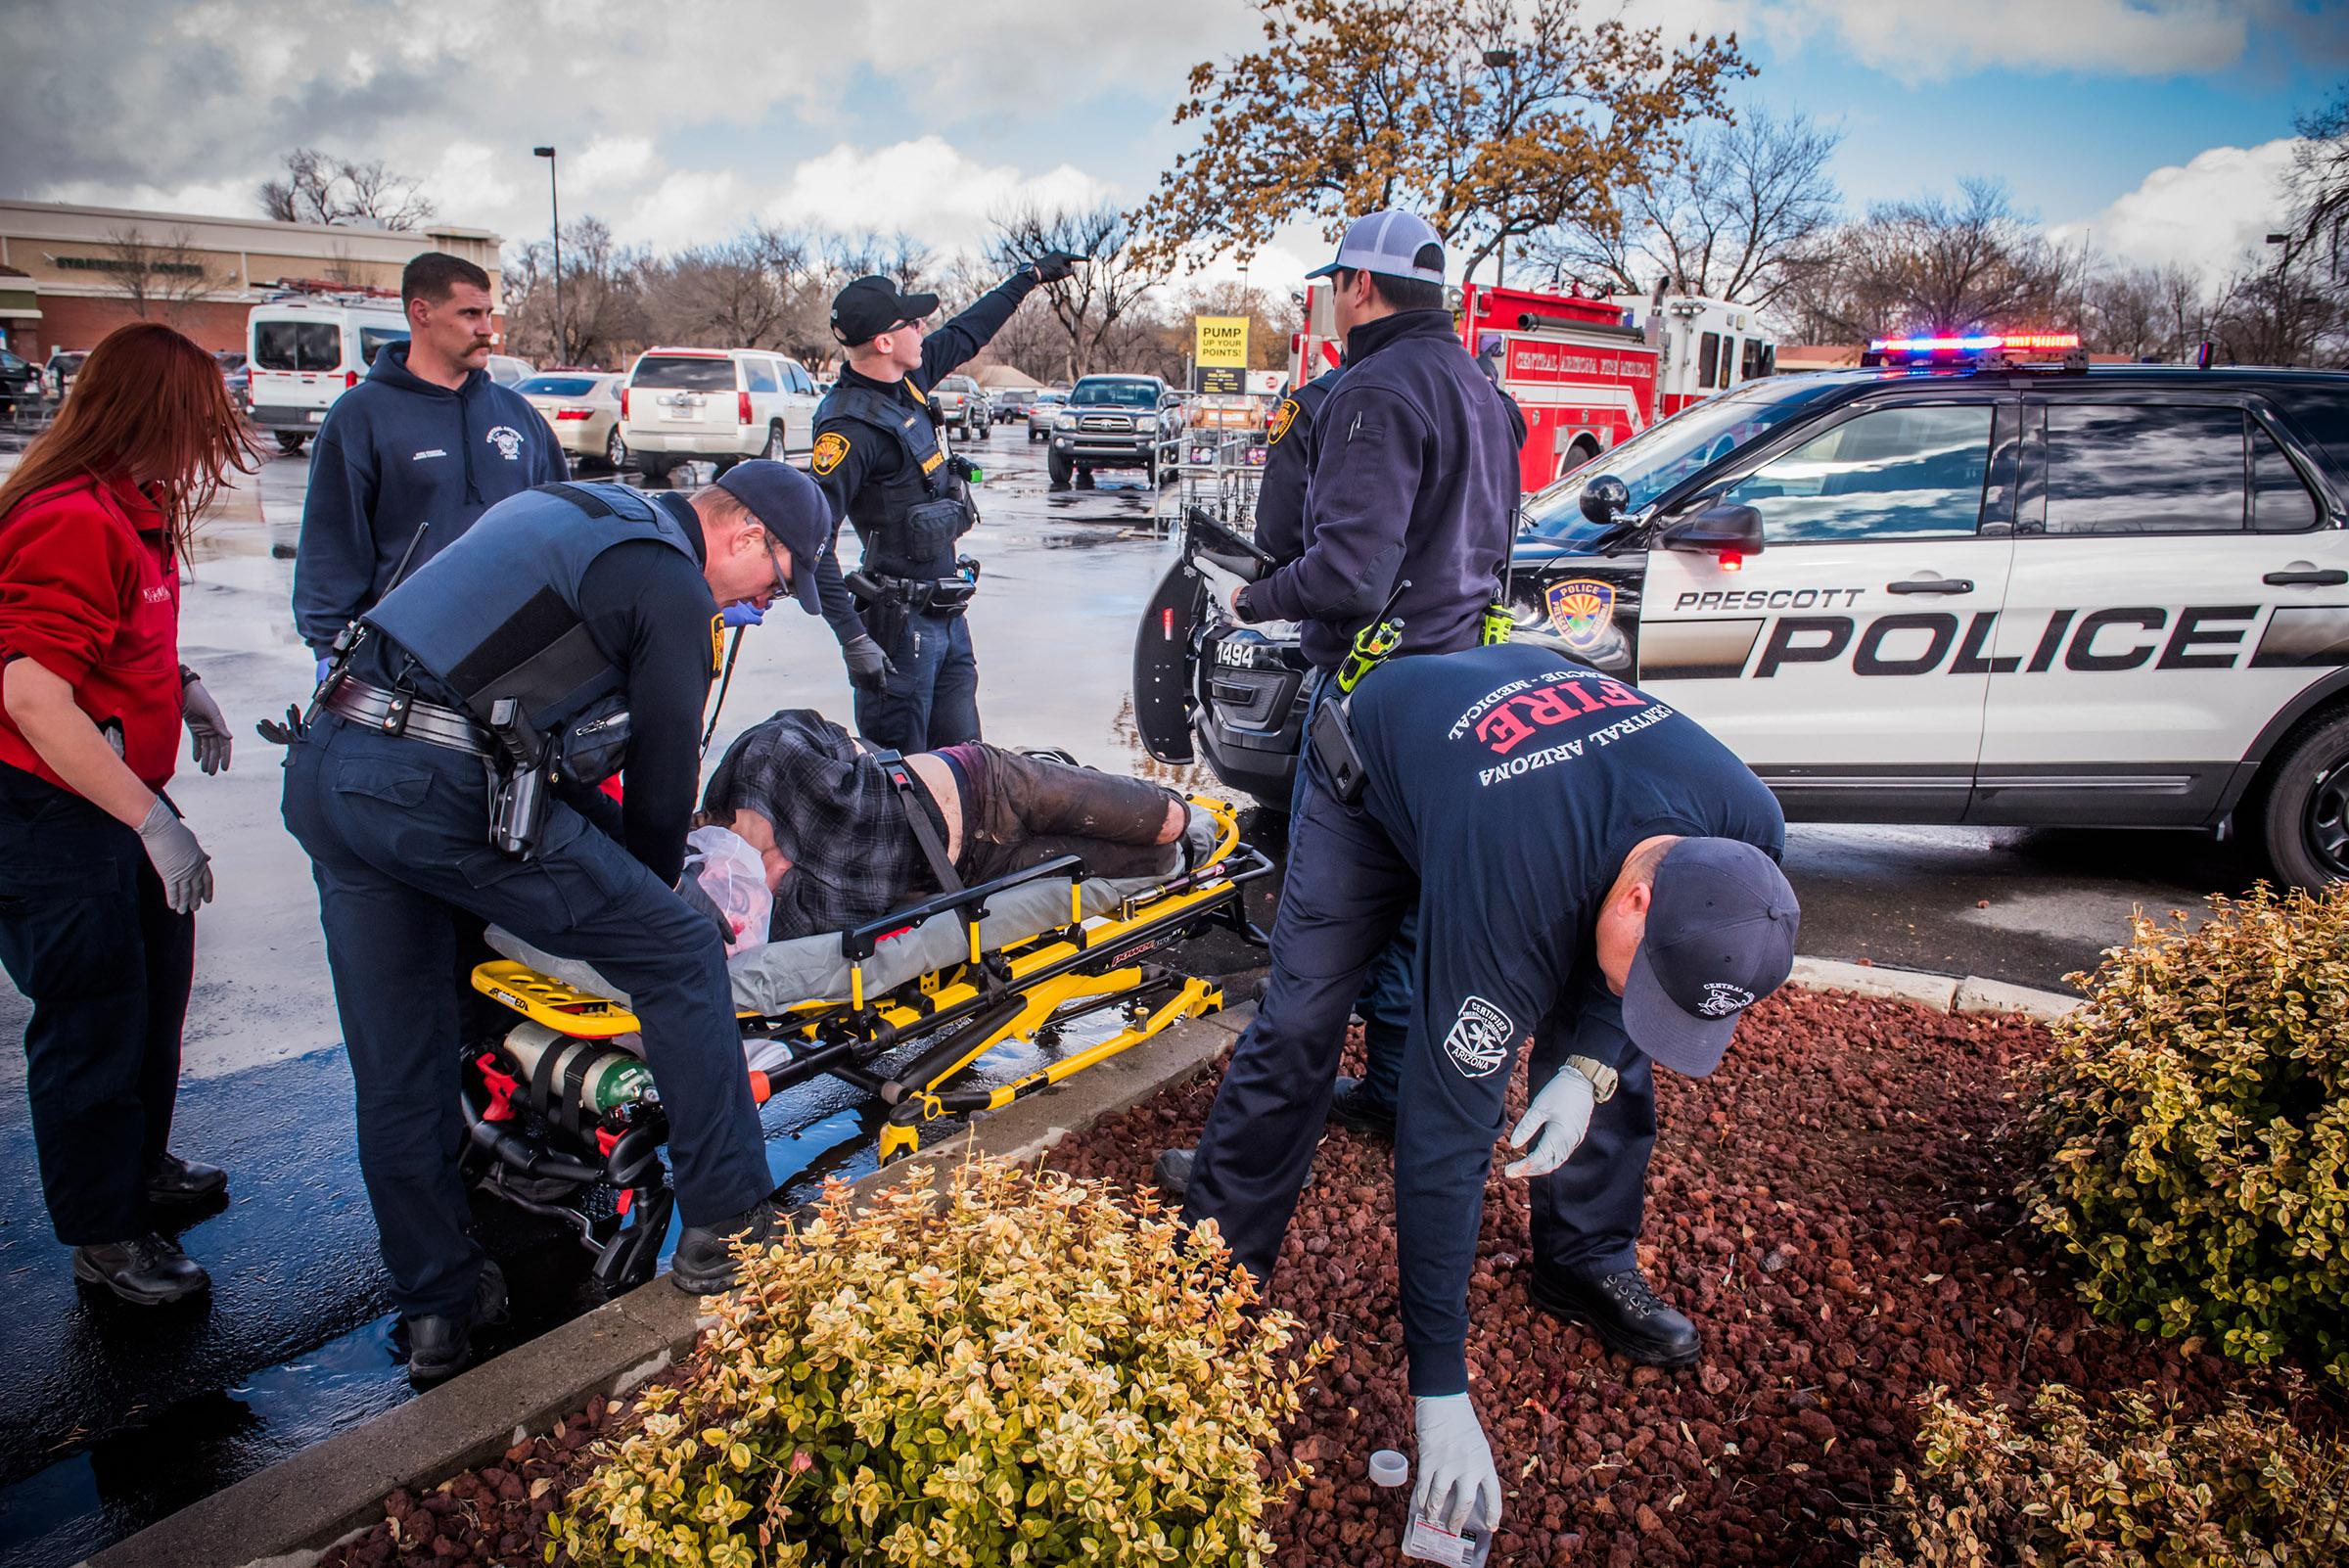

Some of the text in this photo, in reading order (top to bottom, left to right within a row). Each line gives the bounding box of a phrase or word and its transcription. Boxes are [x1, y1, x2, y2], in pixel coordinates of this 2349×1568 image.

[1203, 327, 1242, 338] PUMP
[1202, 348, 1241, 357] POINTS!
[1516, 351, 1558, 372] CENTRAL
[922, 450, 945, 476] POLICE
[1559, 583, 1600, 596] POLICE
[1674, 589, 1865, 612] PRESCOTT
[1752, 604, 2261, 678] POLICE
[1217, 641, 1253, 669] 1494
[1448, 679, 1533, 741] MEDICAL
[1475, 680, 1648, 755] FIRE
[1479, 704, 1674, 787] CENTRAL ARIZONA
[1703, 983, 1743, 992] CENTRAL
[1471, 1001, 1508, 1032] CERTIFIED
[1451, 1047, 1490, 1070] ARIZONA
